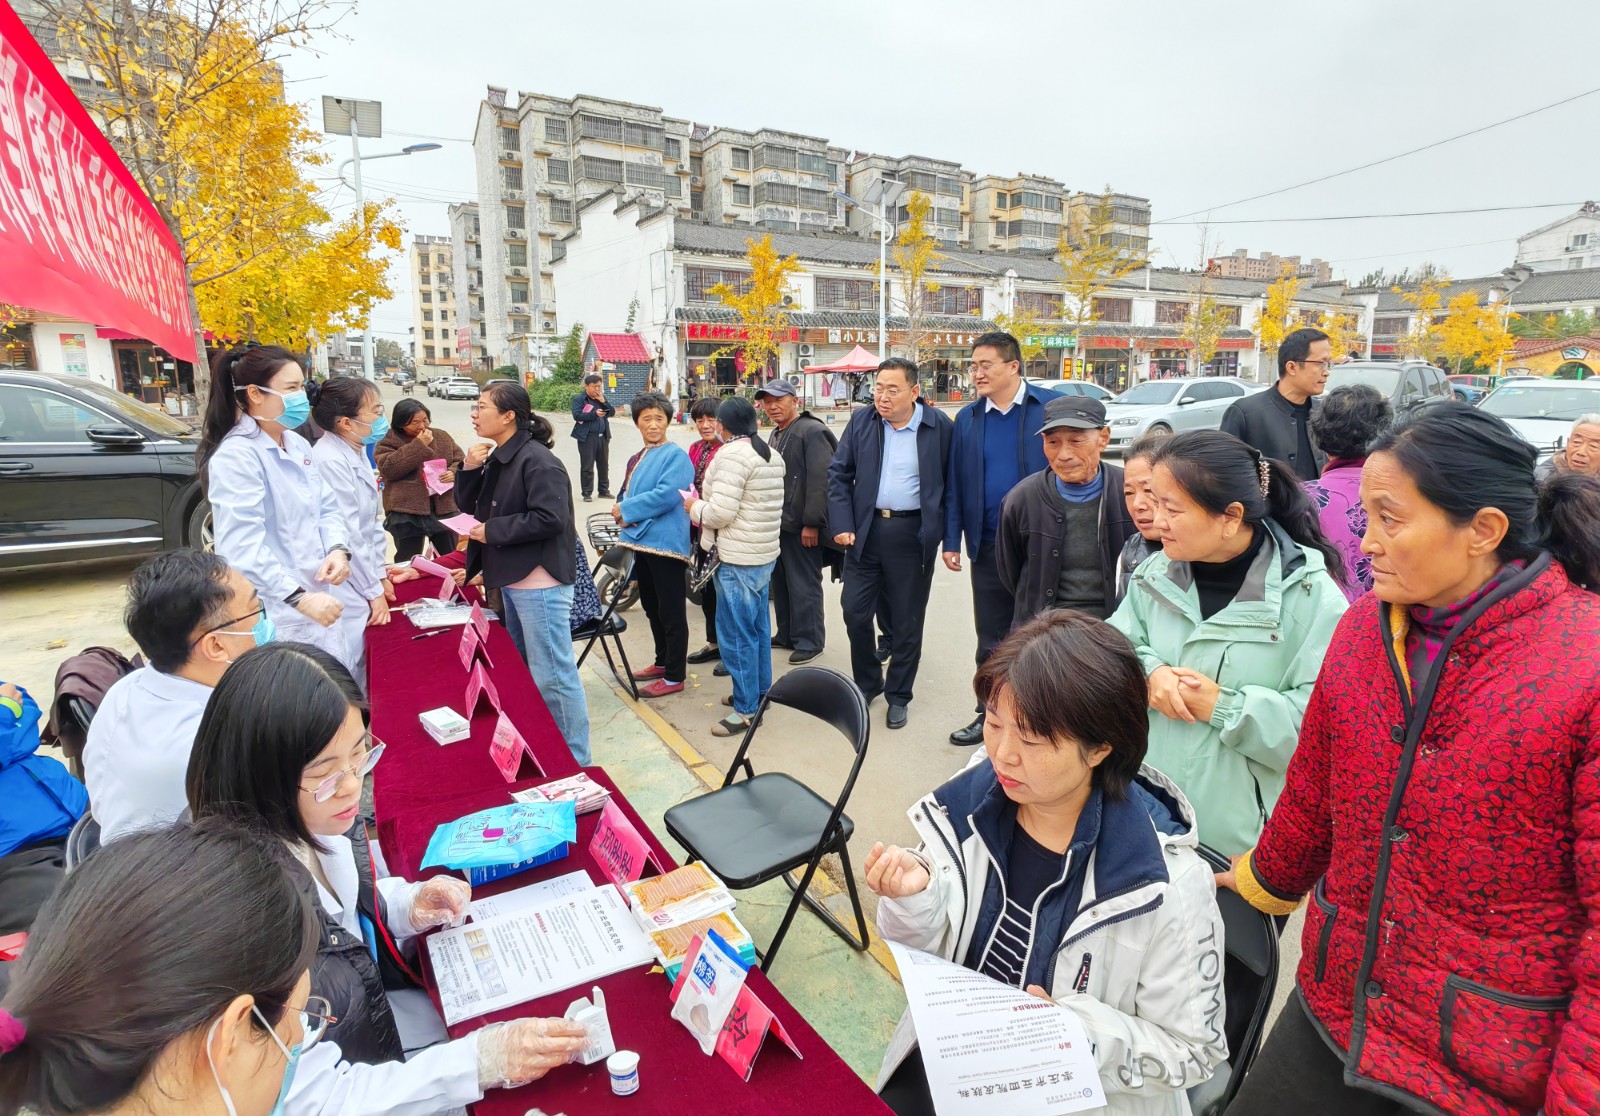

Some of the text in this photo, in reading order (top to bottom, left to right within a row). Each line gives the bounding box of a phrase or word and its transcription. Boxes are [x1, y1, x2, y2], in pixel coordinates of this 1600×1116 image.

[695, 958, 716, 989] 棉签
[957, 1070, 1074, 1098] 枣庄市立四院皮肤科
